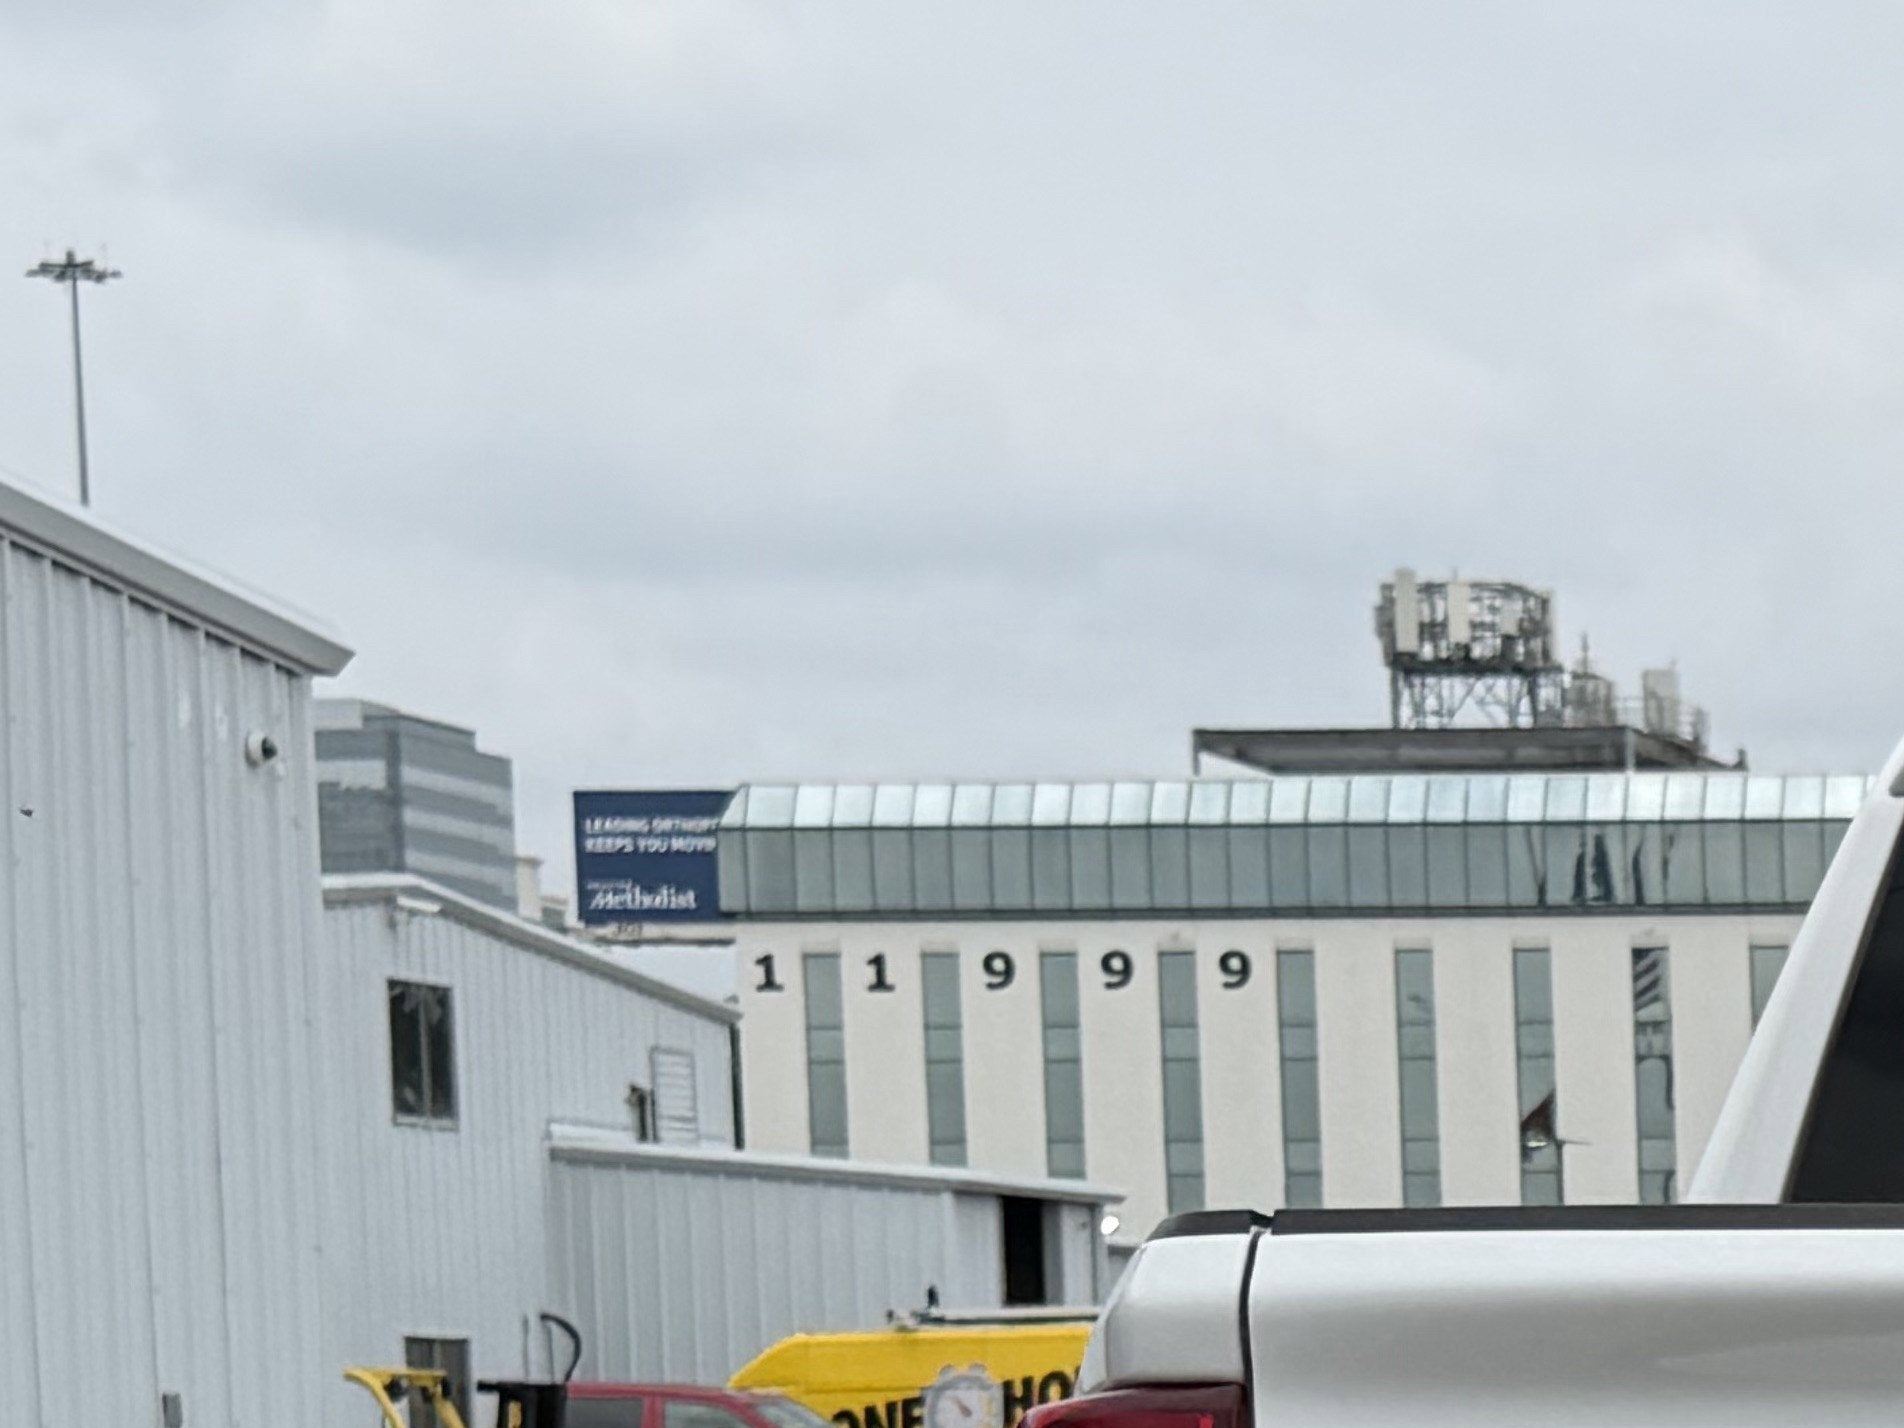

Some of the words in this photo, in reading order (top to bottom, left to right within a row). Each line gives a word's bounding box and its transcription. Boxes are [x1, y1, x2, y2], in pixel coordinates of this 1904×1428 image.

[585, 835, 635, 853] KEEPS
[637, 836, 669, 853] YOU
[588, 885, 697, 910] Methodist
